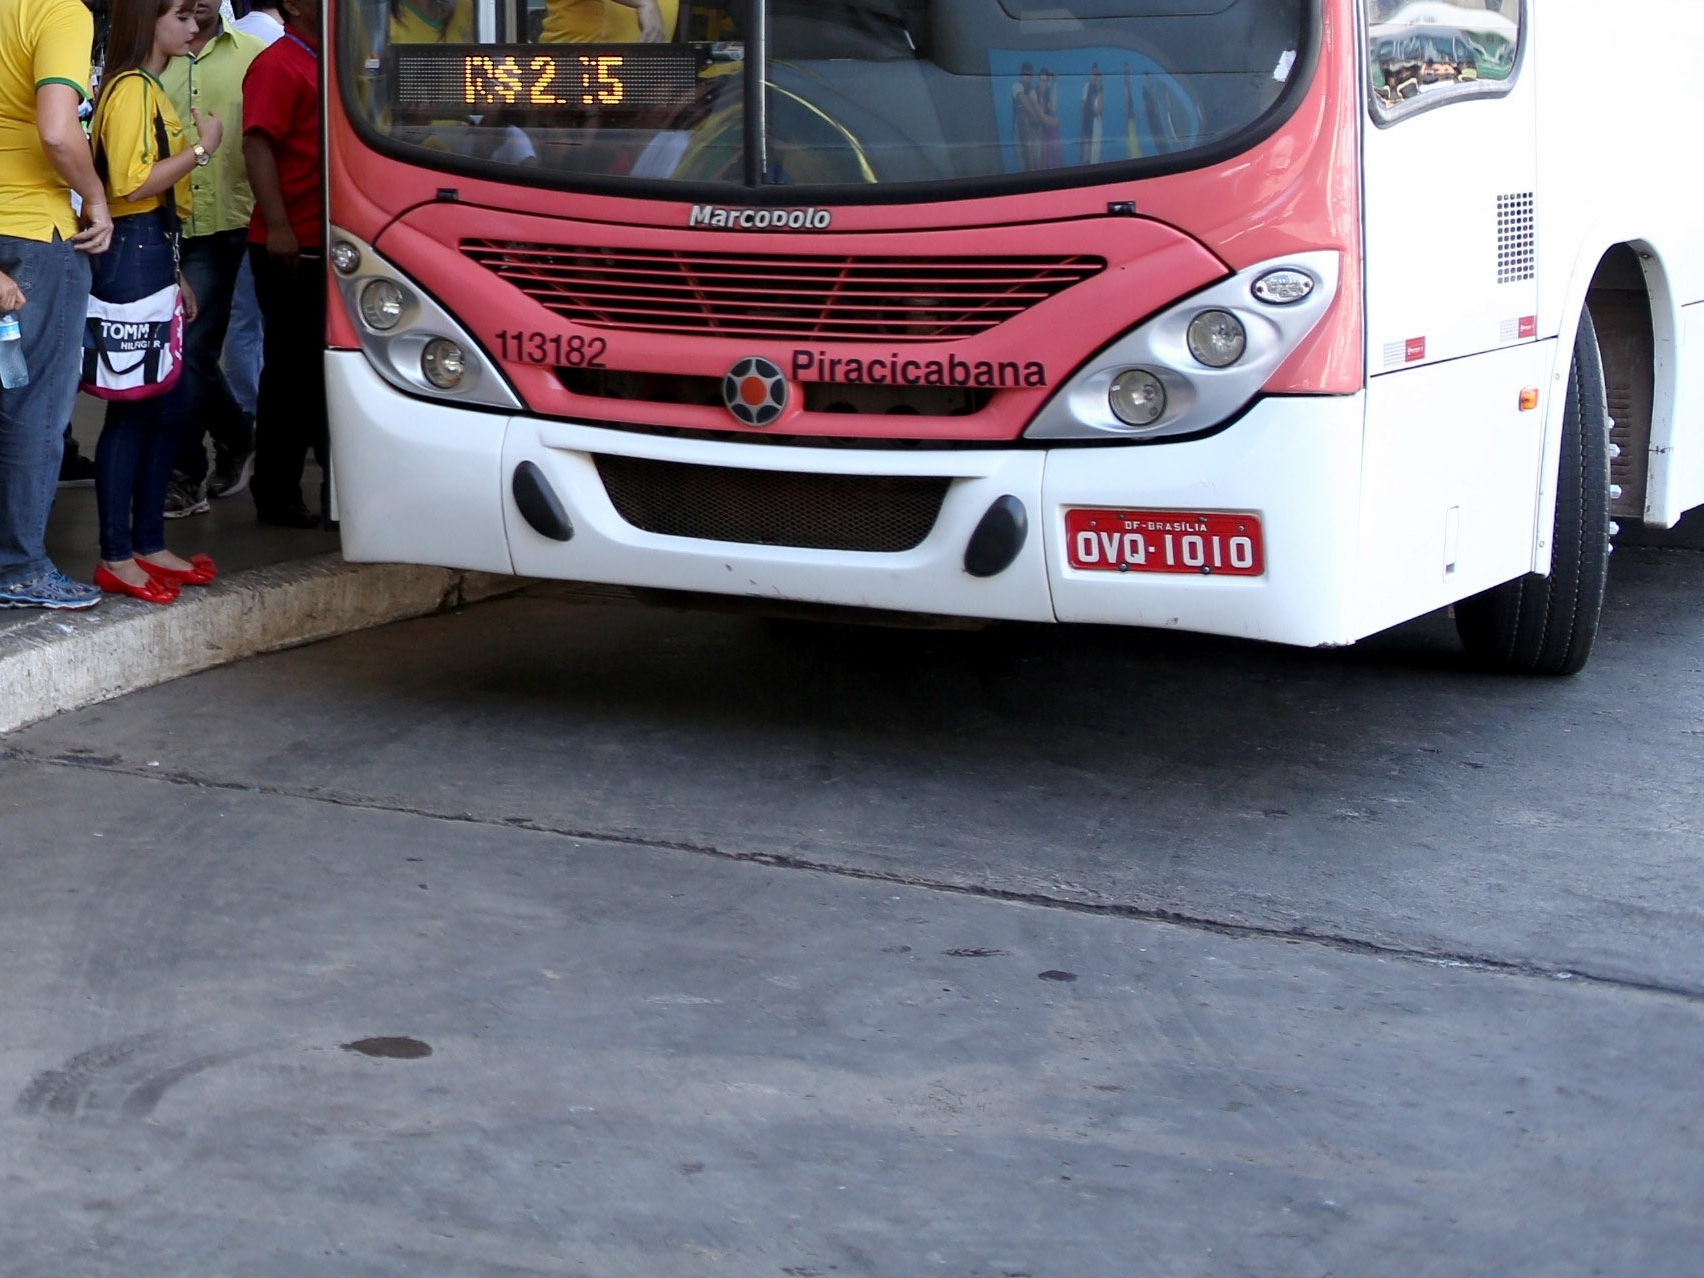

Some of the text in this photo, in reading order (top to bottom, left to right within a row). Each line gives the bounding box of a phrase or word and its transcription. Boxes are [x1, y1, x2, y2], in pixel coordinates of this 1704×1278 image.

[689, 204, 832, 229] Marcopolo
[101, 322, 162, 340] TOMM
[495, 329, 607, 369] 113182
[791, 349, 1048, 388] Piracicabana
